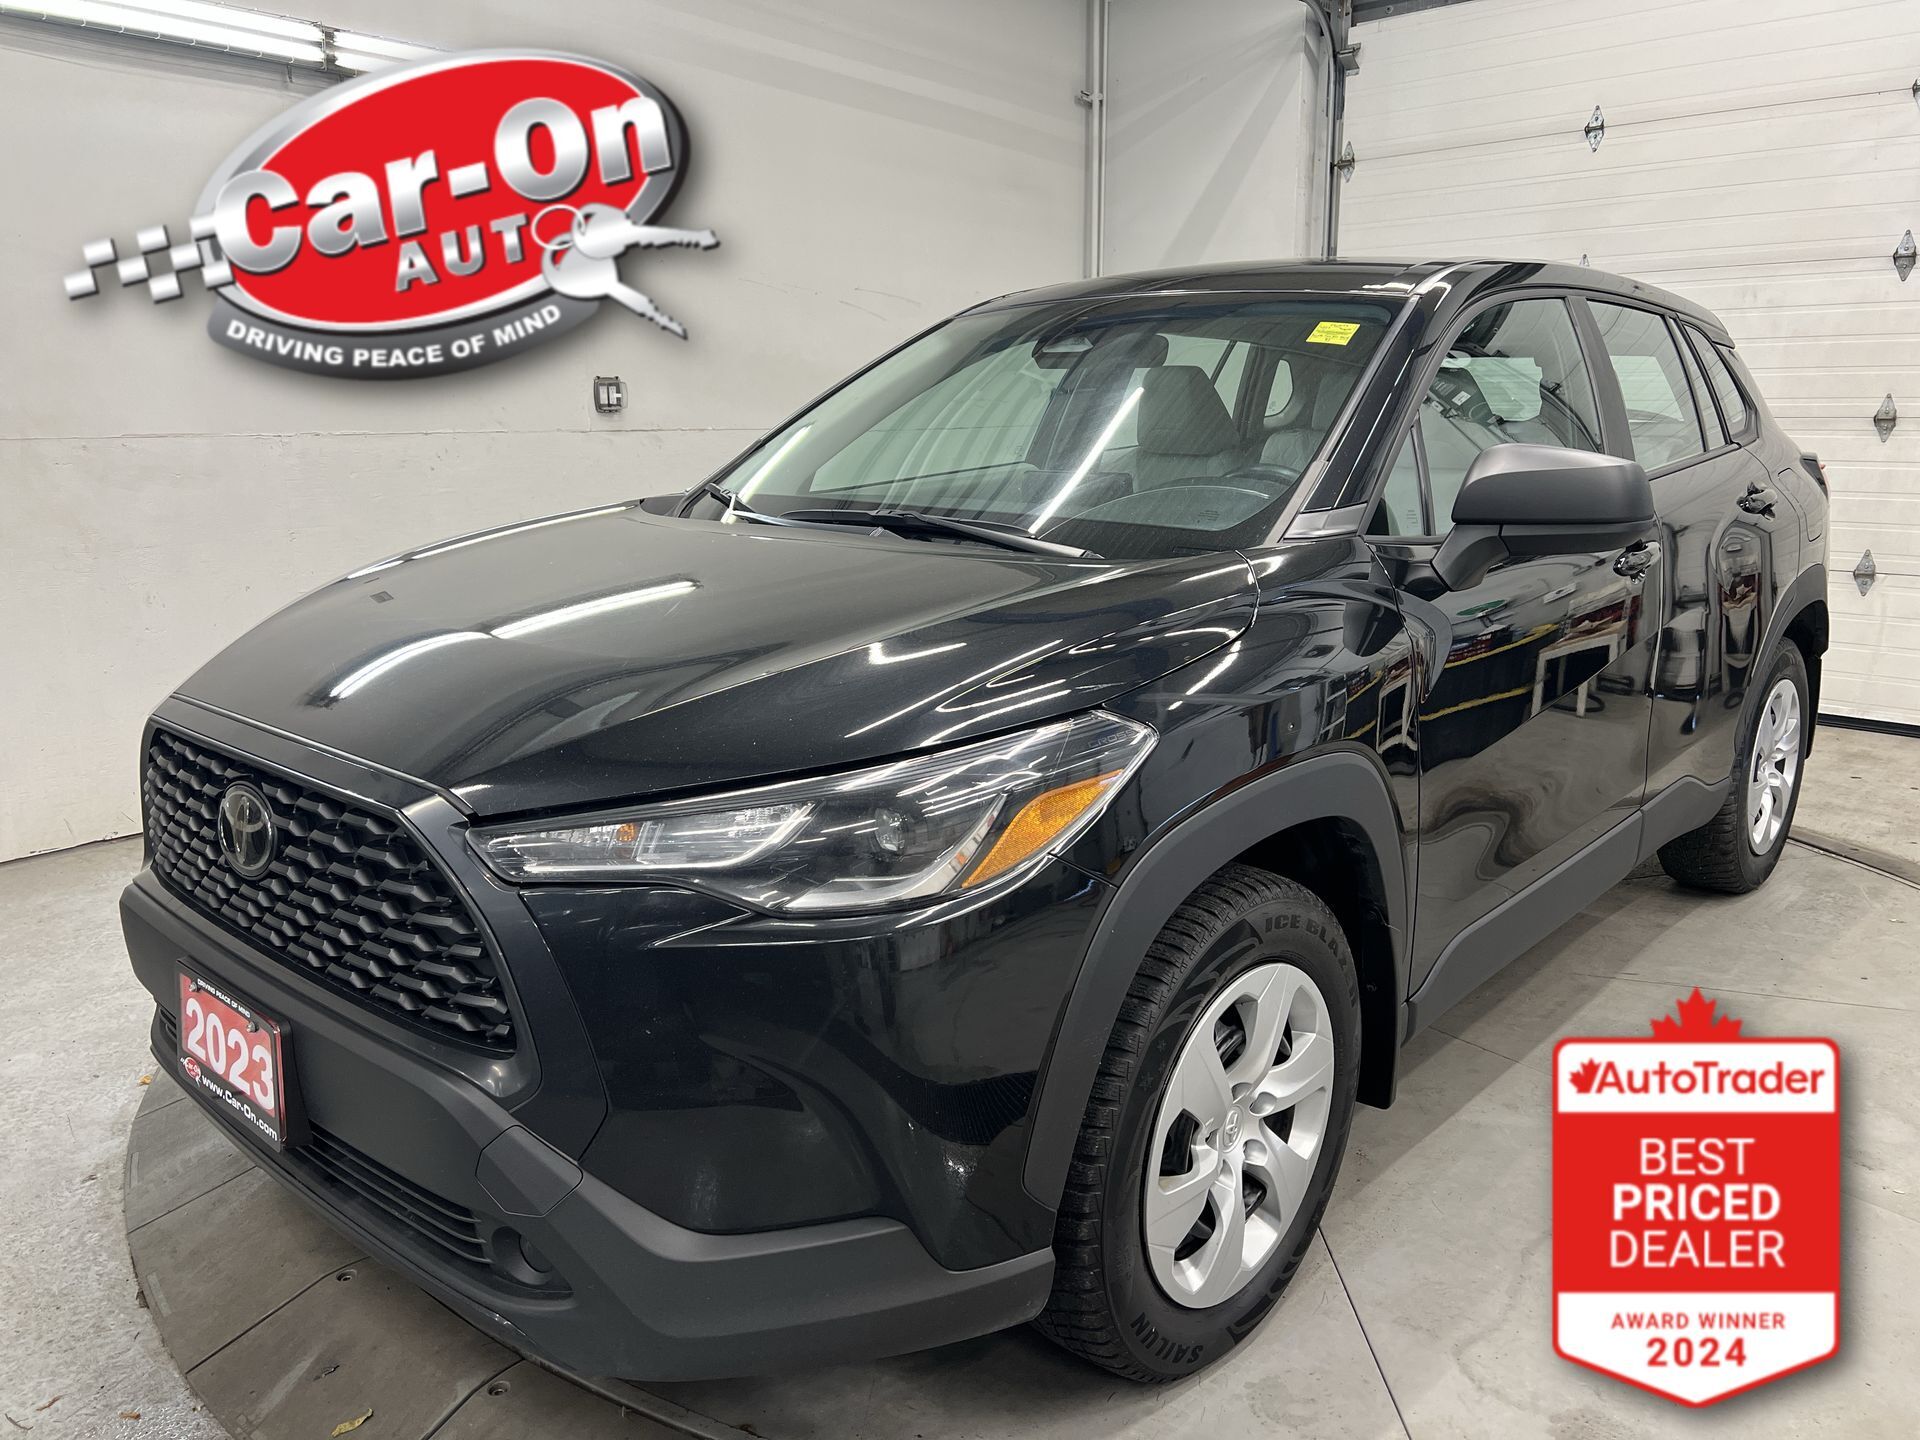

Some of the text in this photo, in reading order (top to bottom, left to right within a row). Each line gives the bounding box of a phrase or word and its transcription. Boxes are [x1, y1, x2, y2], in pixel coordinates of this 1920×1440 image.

[1265, 914, 1301, 933] ICE
[197, 978, 216, 995] DRIVING
[215, 990, 231, 1005] PEACE
[231, 1000, 238, 1009] OF
[186, 997, 275, 1111] 2023
[201, 1075, 278, 1142] www.Car-On.com
[1130, 1311, 1204, 1364] SAILUN
